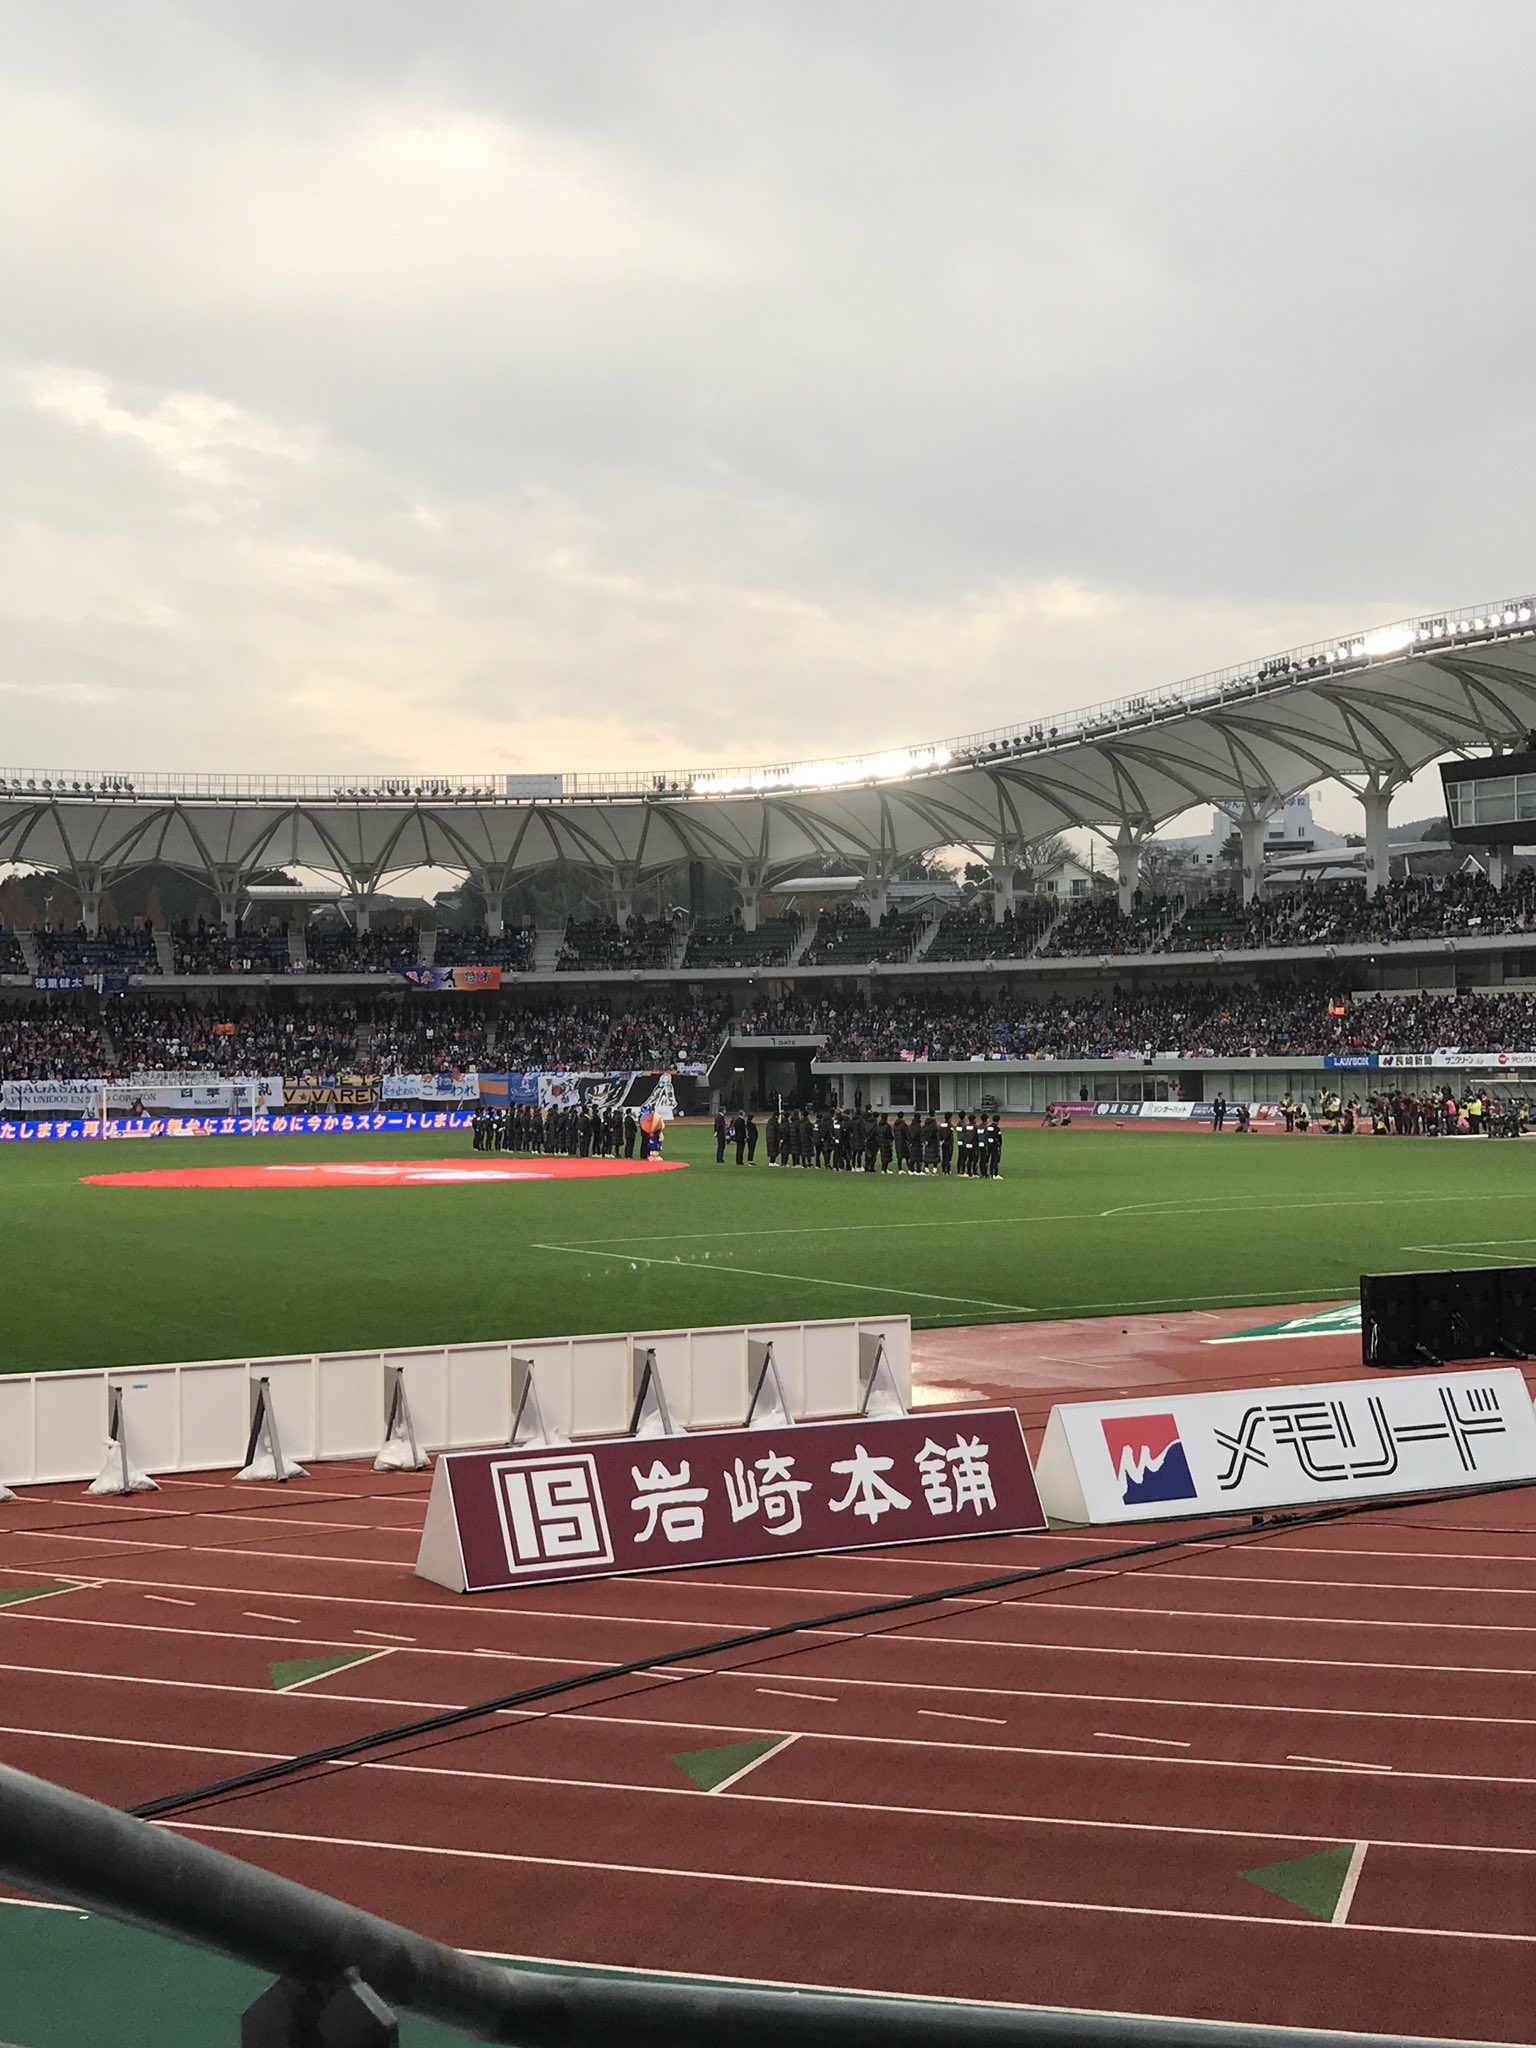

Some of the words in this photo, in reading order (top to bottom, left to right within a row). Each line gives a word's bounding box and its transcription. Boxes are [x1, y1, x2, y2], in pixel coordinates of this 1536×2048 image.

[1333, 1057, 1370, 1066] LAWSON
[1395, 1055, 1432, 1066] 長崎新聞
[283, 1075, 352, 1086] PRIE
[10, 1083, 99, 1094] NAGASAKI
[1213, 1387, 1506, 1491] メモリード
[630, 1433, 998, 1543] 岩崎本舗
